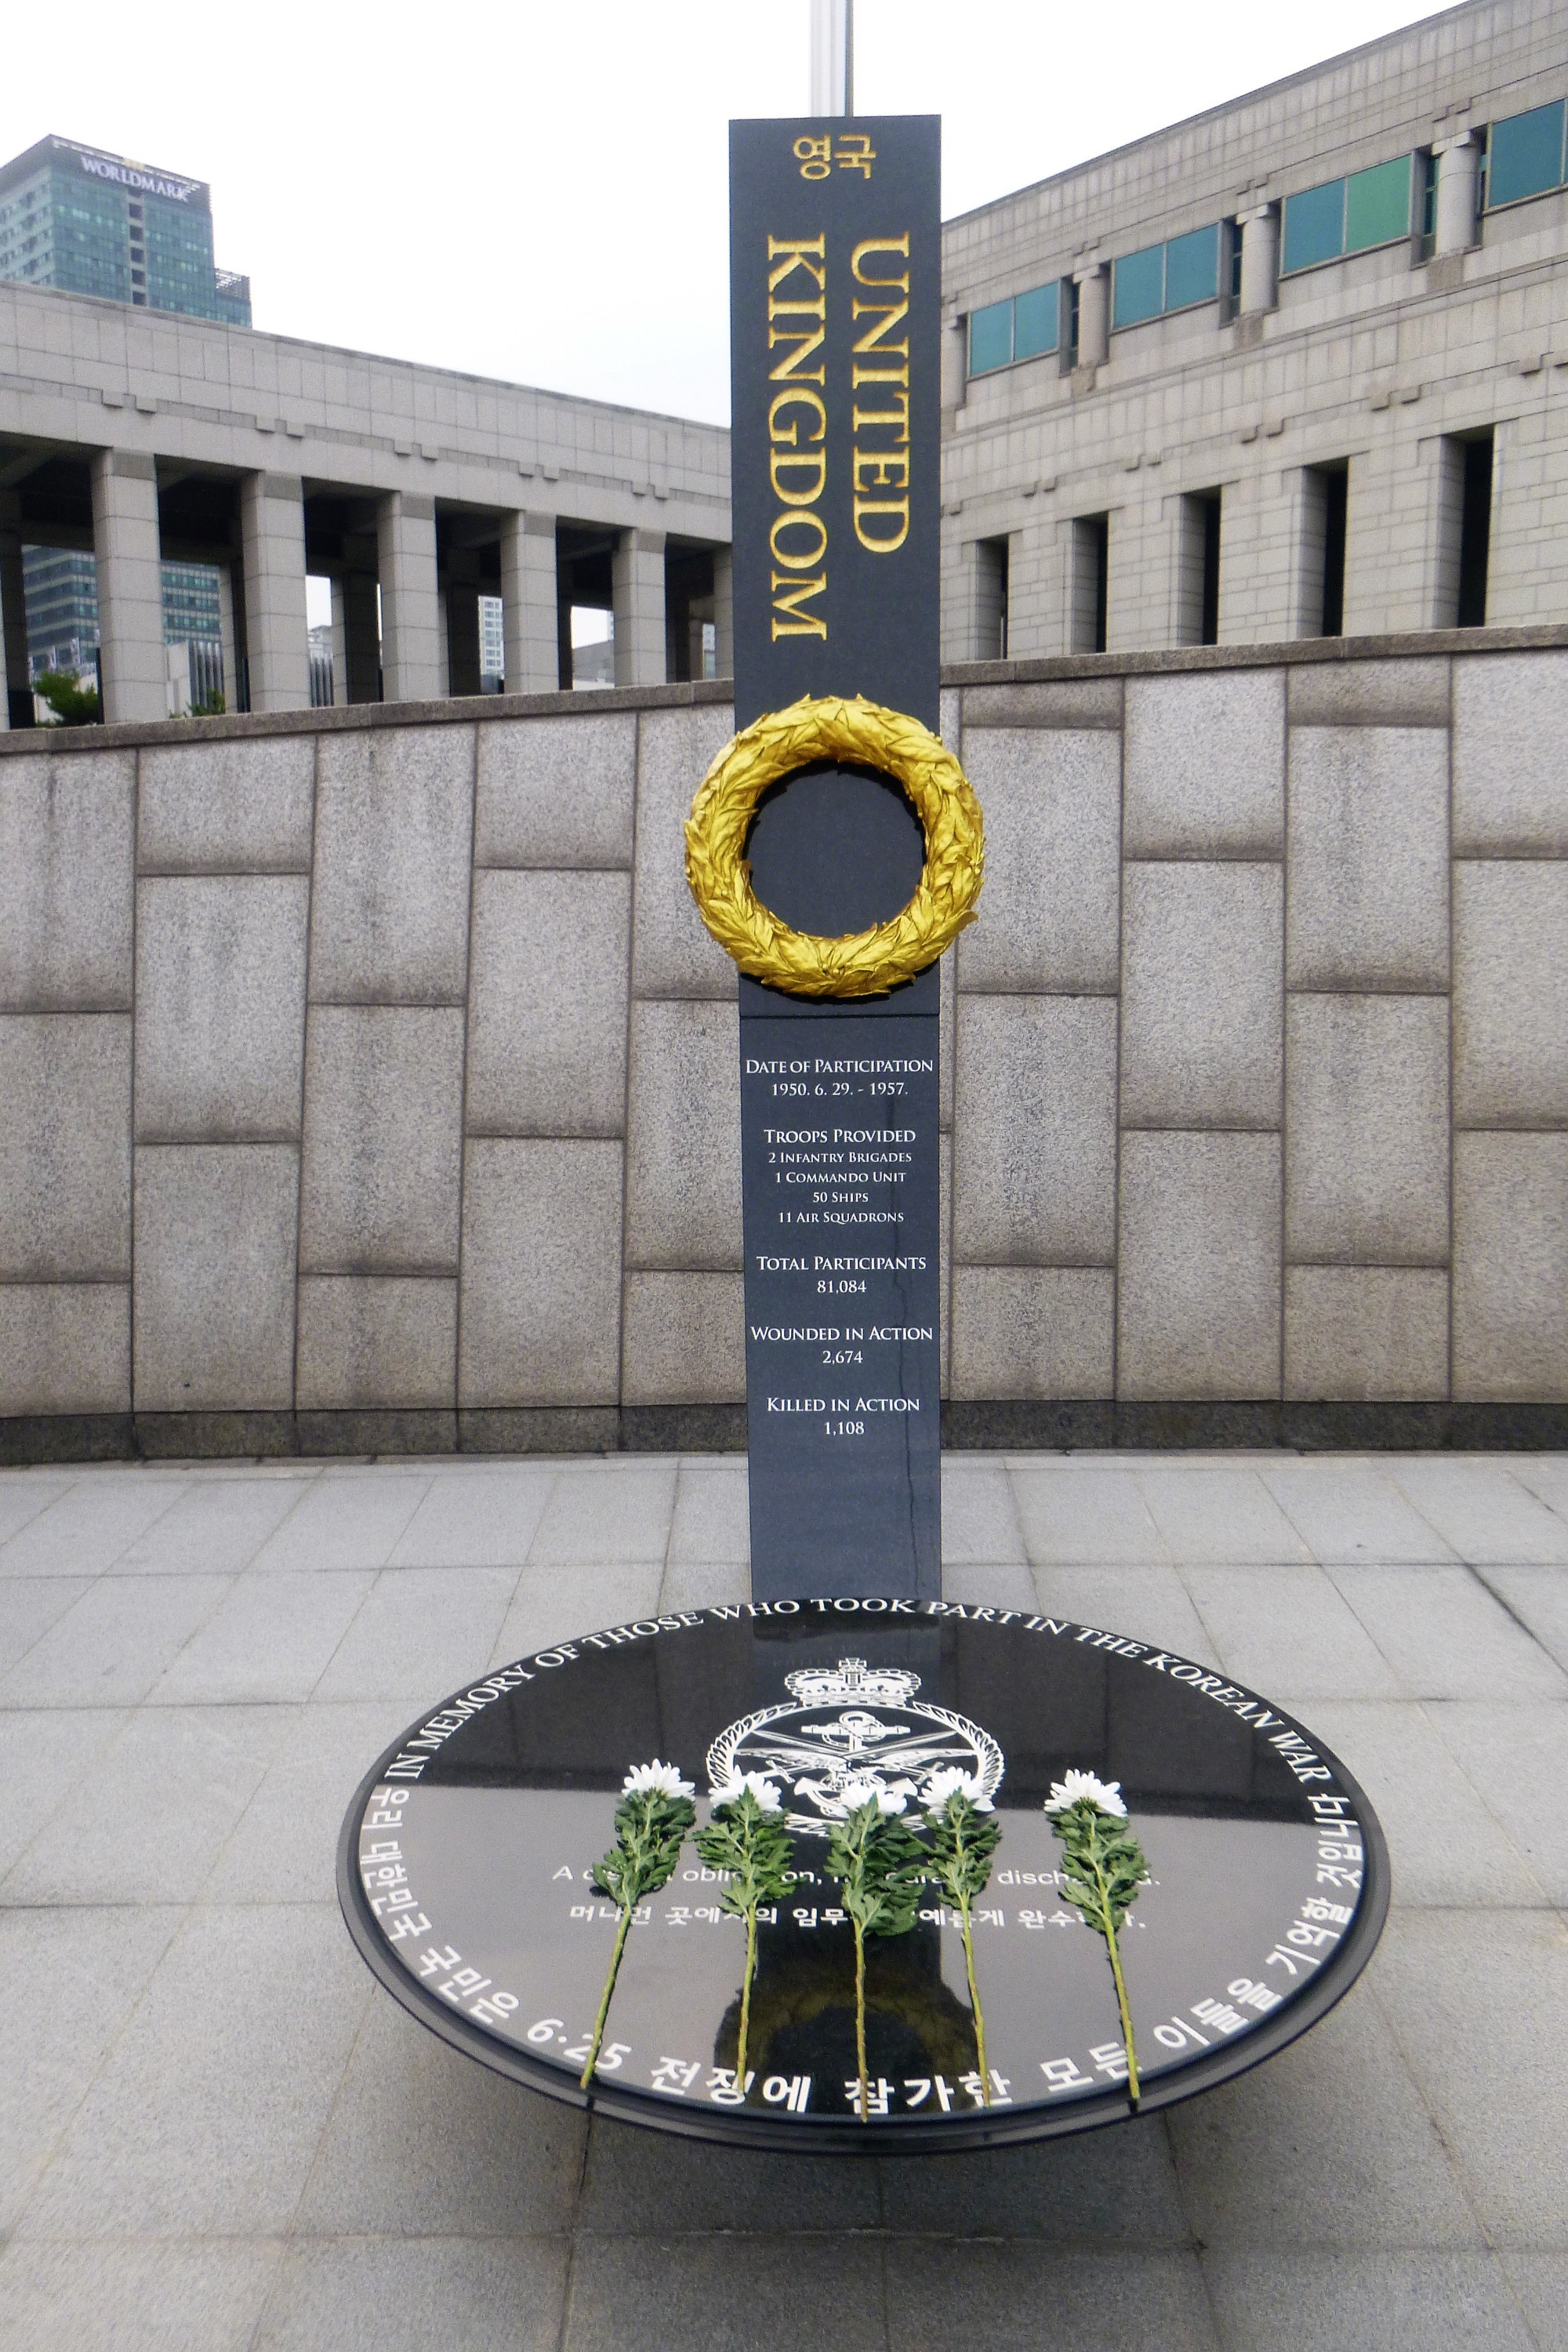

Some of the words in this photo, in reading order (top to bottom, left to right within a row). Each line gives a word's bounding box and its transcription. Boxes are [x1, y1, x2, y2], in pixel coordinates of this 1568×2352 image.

[792, 132, 877, 180] 영국
[80, 154, 189, 202] WORLDMARK
[851, 230, 910, 553] UNITED
[768, 232, 828, 642] KINGDOM
[746, 1059, 787, 1074] DATE
[789, 1061, 811, 1073] OF
[815, 1059, 934, 1073] PARTICIPATION
[771, 1083, 811, 1096] 1950.
[815, 1083, 827, 1096] 6.
[832, 1083, 853, 1096] 29.
[869, 1082, 909, 1095] 1957.
[764, 1130, 828, 1144] TROOPS
[833, 1129, 916, 1143] PROVIDED
[768, 1152, 776, 1163] 2
[780, 1152, 844, 1163] INFANTRY
[848, 1152, 912, 1163] BRIGADES
[775, 1172, 781, 1183] 1
[786, 1172, 869, 1183] COMMANDO
[873, 1171, 906, 1182] UNIT
[812, 1192, 828, 1203] 50
[831, 1192, 869, 1203] SHIPS
[779, 1212, 792, 1223] 11
[797, 1212, 819, 1223] AIR
[823, 1212, 904, 1225] SQUADRONS
[757, 1256, 809, 1270] TOTAL
[814, 1256, 927, 1270] PARTICIPANTS
[817, 1280, 867, 1294] 81,084
[751, 1327, 840, 1341] WOUNDED
[846, 1327, 864, 1341] IN
[869, 1326, 934, 1341] ACTION
[822, 1351, 863, 1364] 2,674
[767, 1397, 826, 1411] KILLED
[831, 1399, 850, 1411] IN
[855, 1397, 920, 1411] ACTION
[824, 1421, 865, 1436] 1,108
[385, 1753, 431, 1779] IN
[408, 1664, 535, 1751] MEMORY
[535, 1644, 580, 1668] OF
[581, 1611, 705, 1649] THOSE
[710, 1599, 800, 1621] WHO
[810, 1598, 916, 1613] TOOK
[927, 1601, 1022, 1624] PART
[1022, 1615, 1072, 1635] IN
[1073, 1628, 1149, 1658] THE
[1143, 1651, 1285, 1729] KOREAN
[1269, 1730, 1333, 1784] WAR
[361, 1788, 410, 1830] 우리
[1307, 1793, 1364, 1889] 것입니다
[552, 1865, 574, 1880] A
[682, 1867, 822, 1886] oblion,
[361, 1841, 432, 1940] 대한민국
[570, 1905, 652, 1925] 머나먼
[911, 1908, 1005, 1929] 예롭게
[1018, 1909, 1146, 1929] 완수.
[1265, 1896, 1353, 1975] 기억할
[419, 1945, 520, 2024] 국민은
[1154, 1978, 1286, 2049] 이들을
[1040, 2042, 1143, 2092] 모든
[844, 2069, 1014, 2114] 참가한
